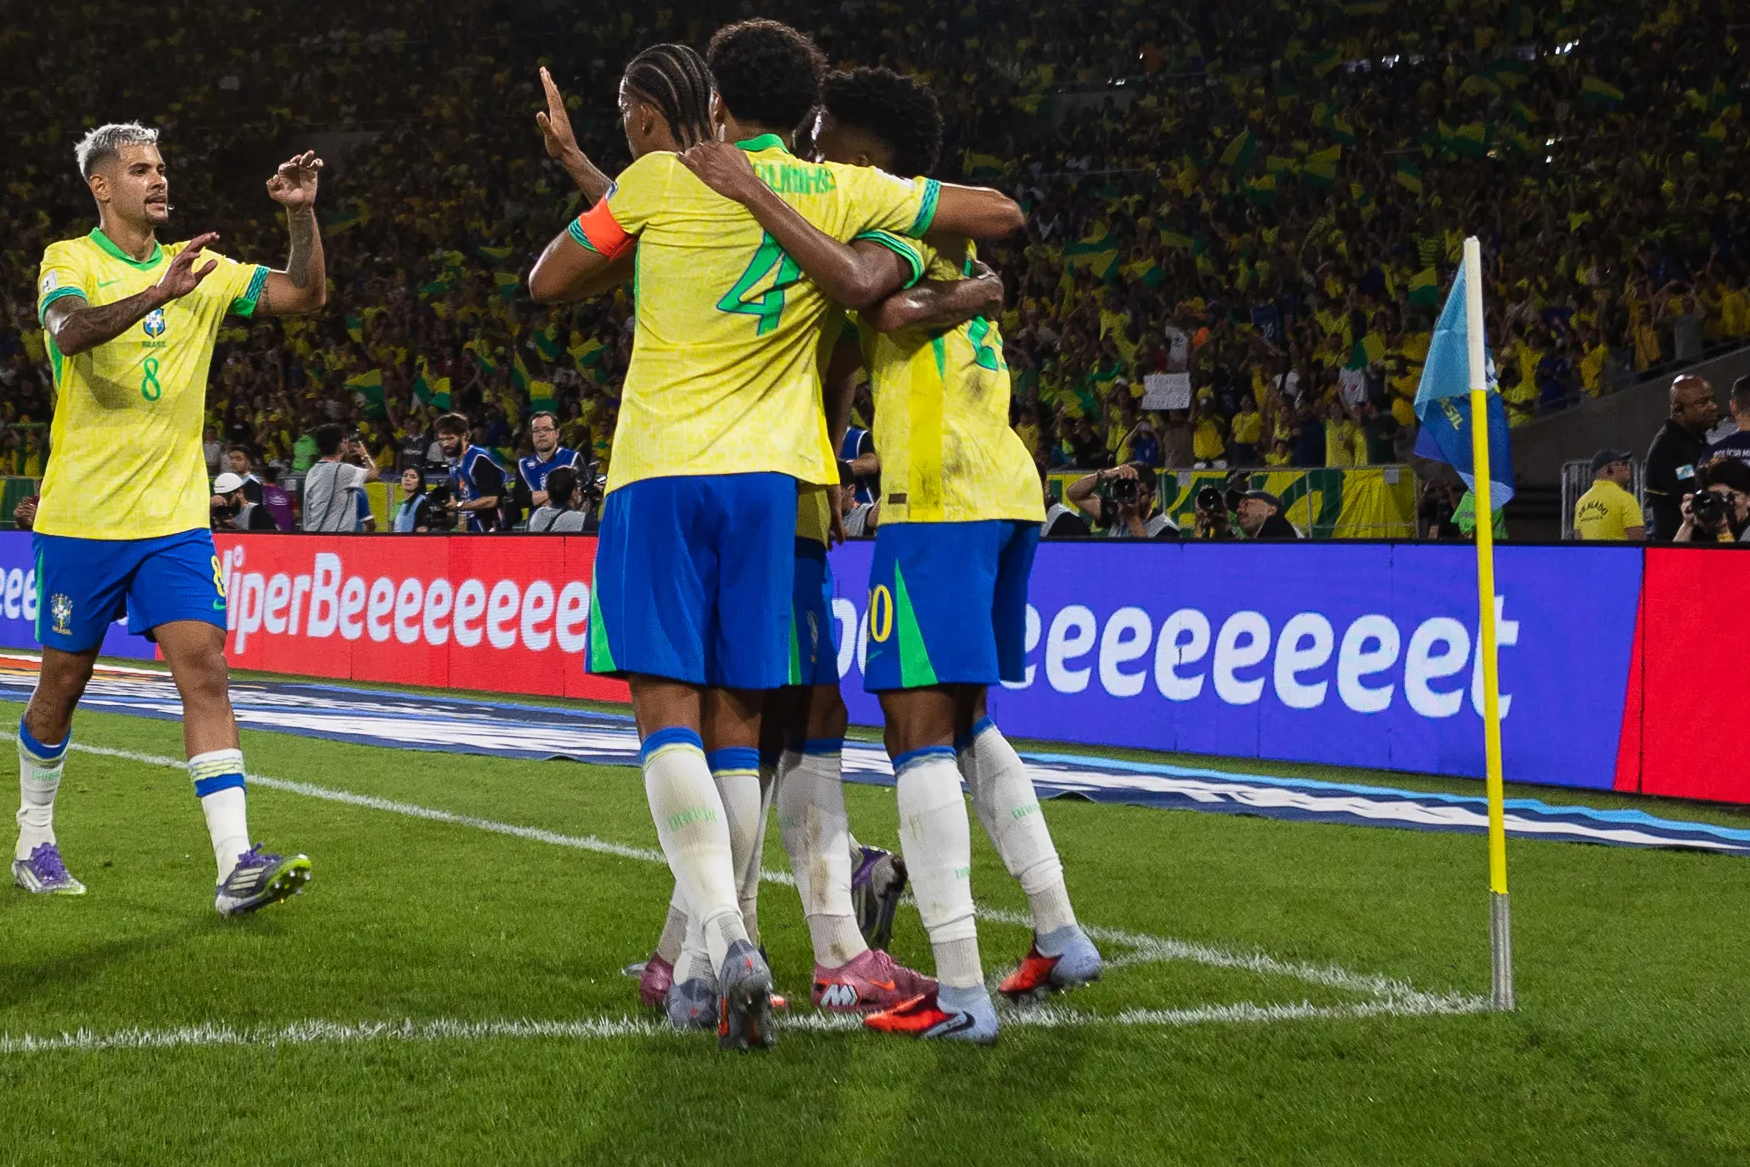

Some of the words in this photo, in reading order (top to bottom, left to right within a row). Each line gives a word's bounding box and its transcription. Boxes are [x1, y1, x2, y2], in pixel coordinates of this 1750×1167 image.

[716, 230, 802, 337] 4
[141, 357, 161, 402] 8
[867, 584, 893, 643] 0
